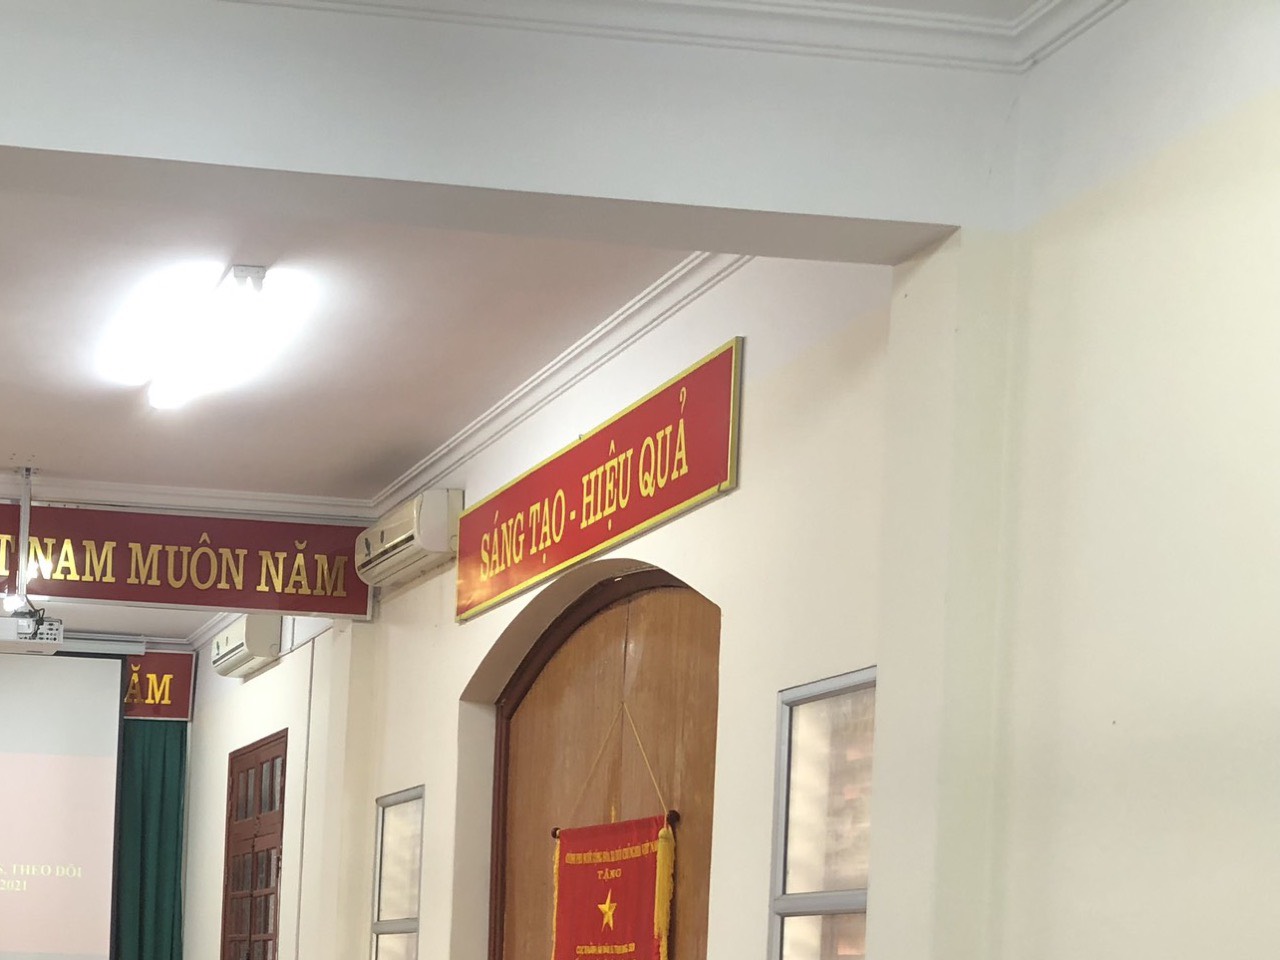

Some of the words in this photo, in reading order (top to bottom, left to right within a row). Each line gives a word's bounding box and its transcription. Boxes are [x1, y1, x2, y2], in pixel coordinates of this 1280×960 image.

[480, 509, 525, 582] SÁNG
[529, 488, 566, 564] TẠO
[579, 439, 634, 532] HIỆU
[638, 386, 689, 498] QUẢ
[27, 535, 117, 583] NAM
[127, 531, 248, 591] MUÔN
[255, 540, 349, 598] NĂM
[123, 663, 174, 705] ĂM
[12, 863, 52, 876] THEO
